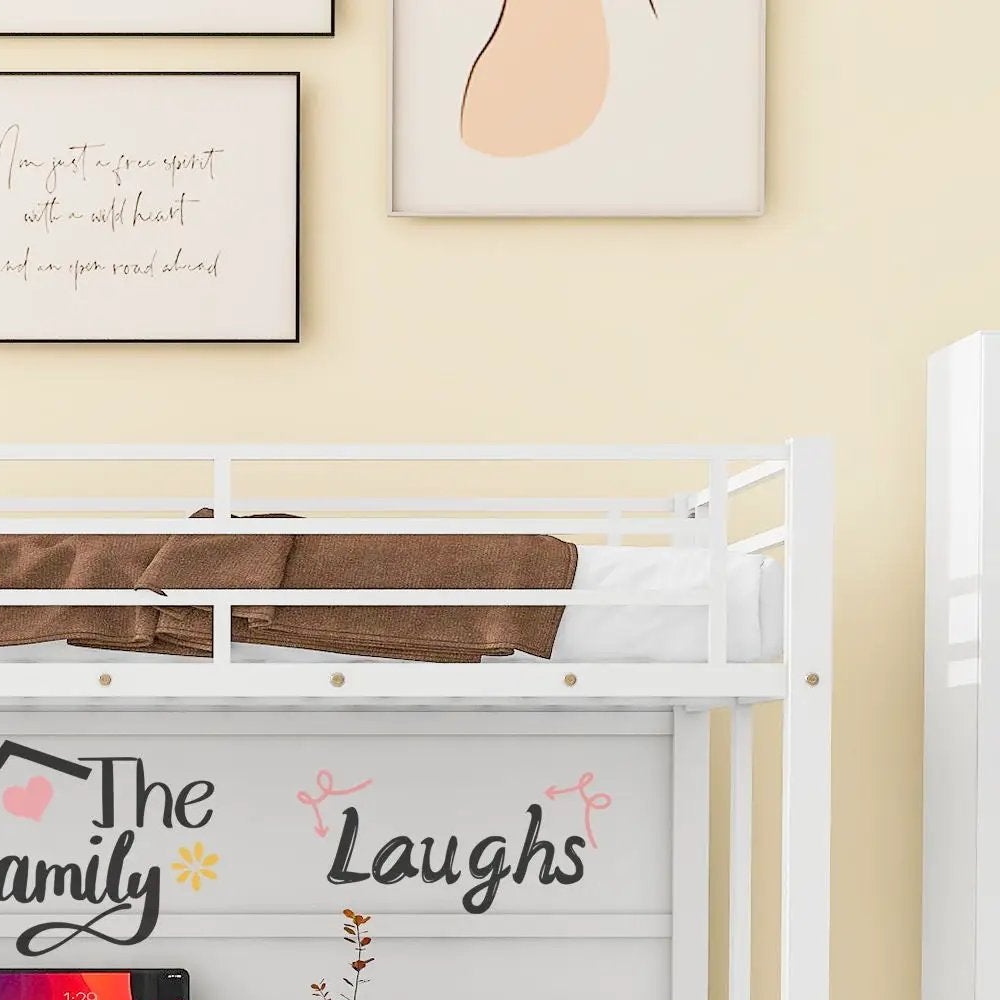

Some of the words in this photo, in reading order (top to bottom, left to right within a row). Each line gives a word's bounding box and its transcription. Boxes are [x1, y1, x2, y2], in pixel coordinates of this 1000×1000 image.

[45, 144, 105, 193] just
[163, 148, 224, 188] spirit
[132, 190, 200, 227] heart
[112, 249, 158, 277] road
[77, 757, 215, 829] The
[326, 803, 586, 915] Laughs
